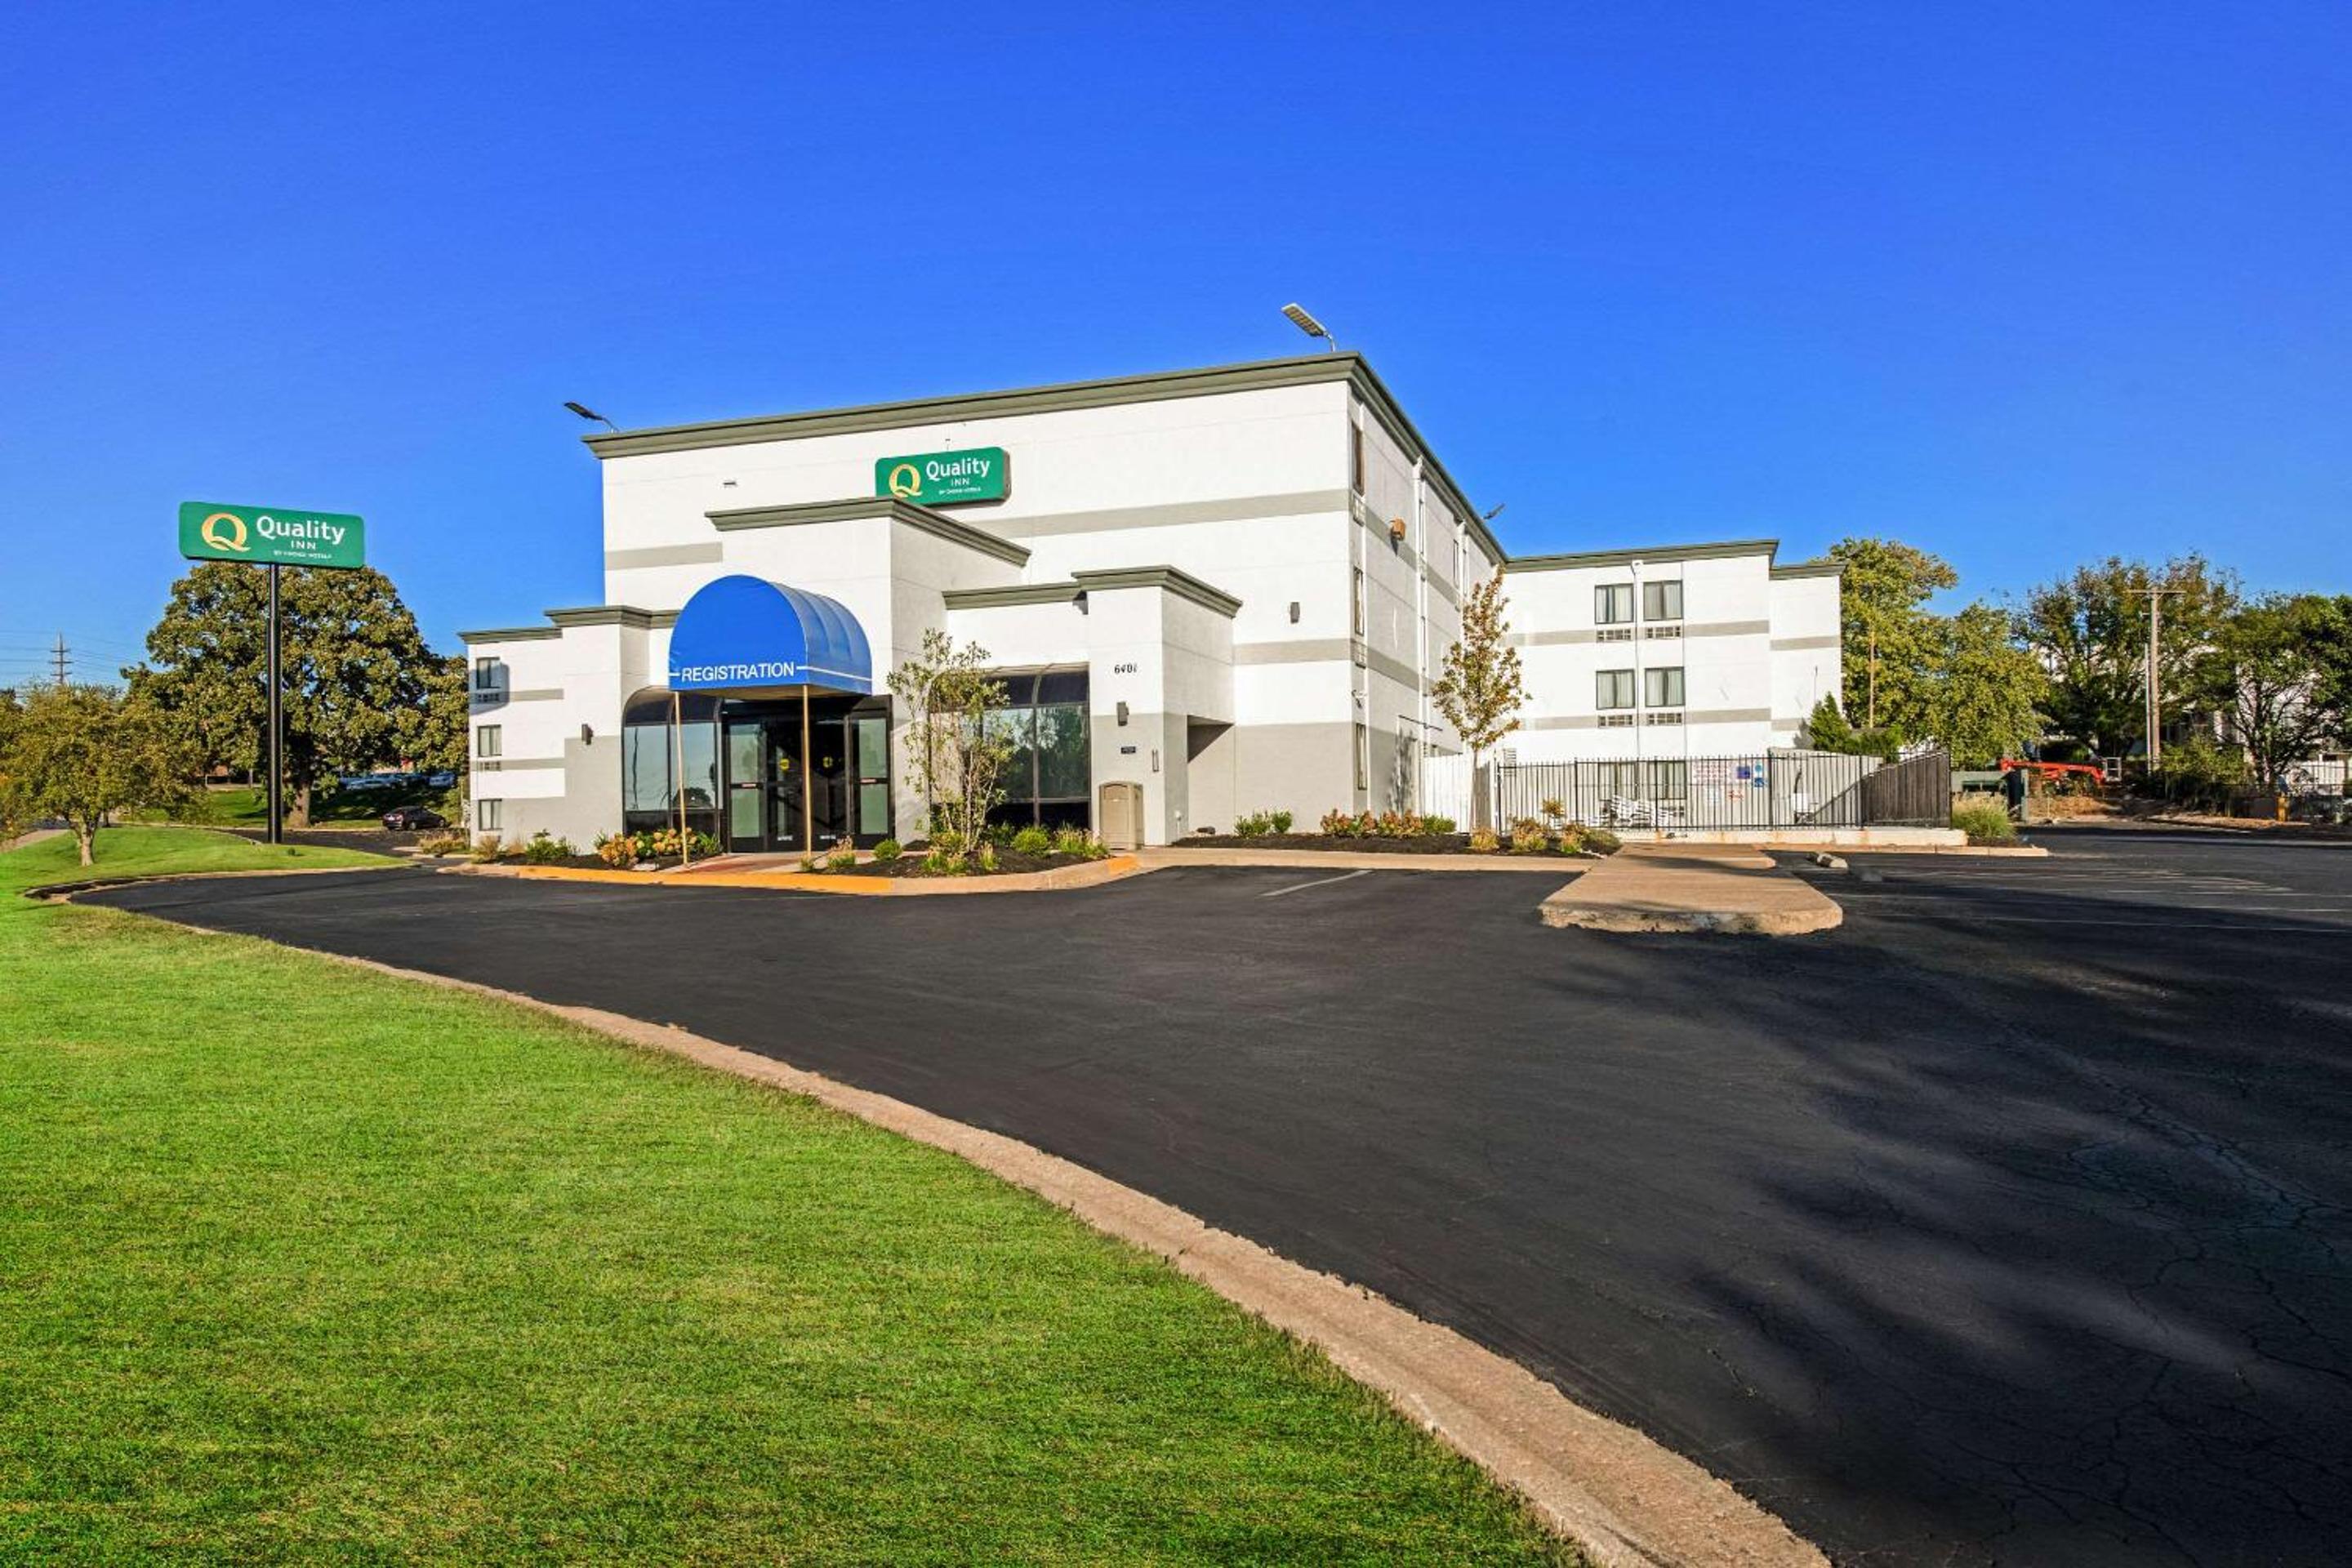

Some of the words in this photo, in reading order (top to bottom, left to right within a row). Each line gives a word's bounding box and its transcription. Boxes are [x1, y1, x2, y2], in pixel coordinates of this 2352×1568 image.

[889, 464, 923, 498] Q
[925, 457, 991, 482] Quality
[951, 478, 970, 487] INN
[202, 513, 251, 552] Q
[256, 515, 345, 545] Quality
[291, 540, 316, 550] INN
[681, 662, 795, 683] REGISTRATION
